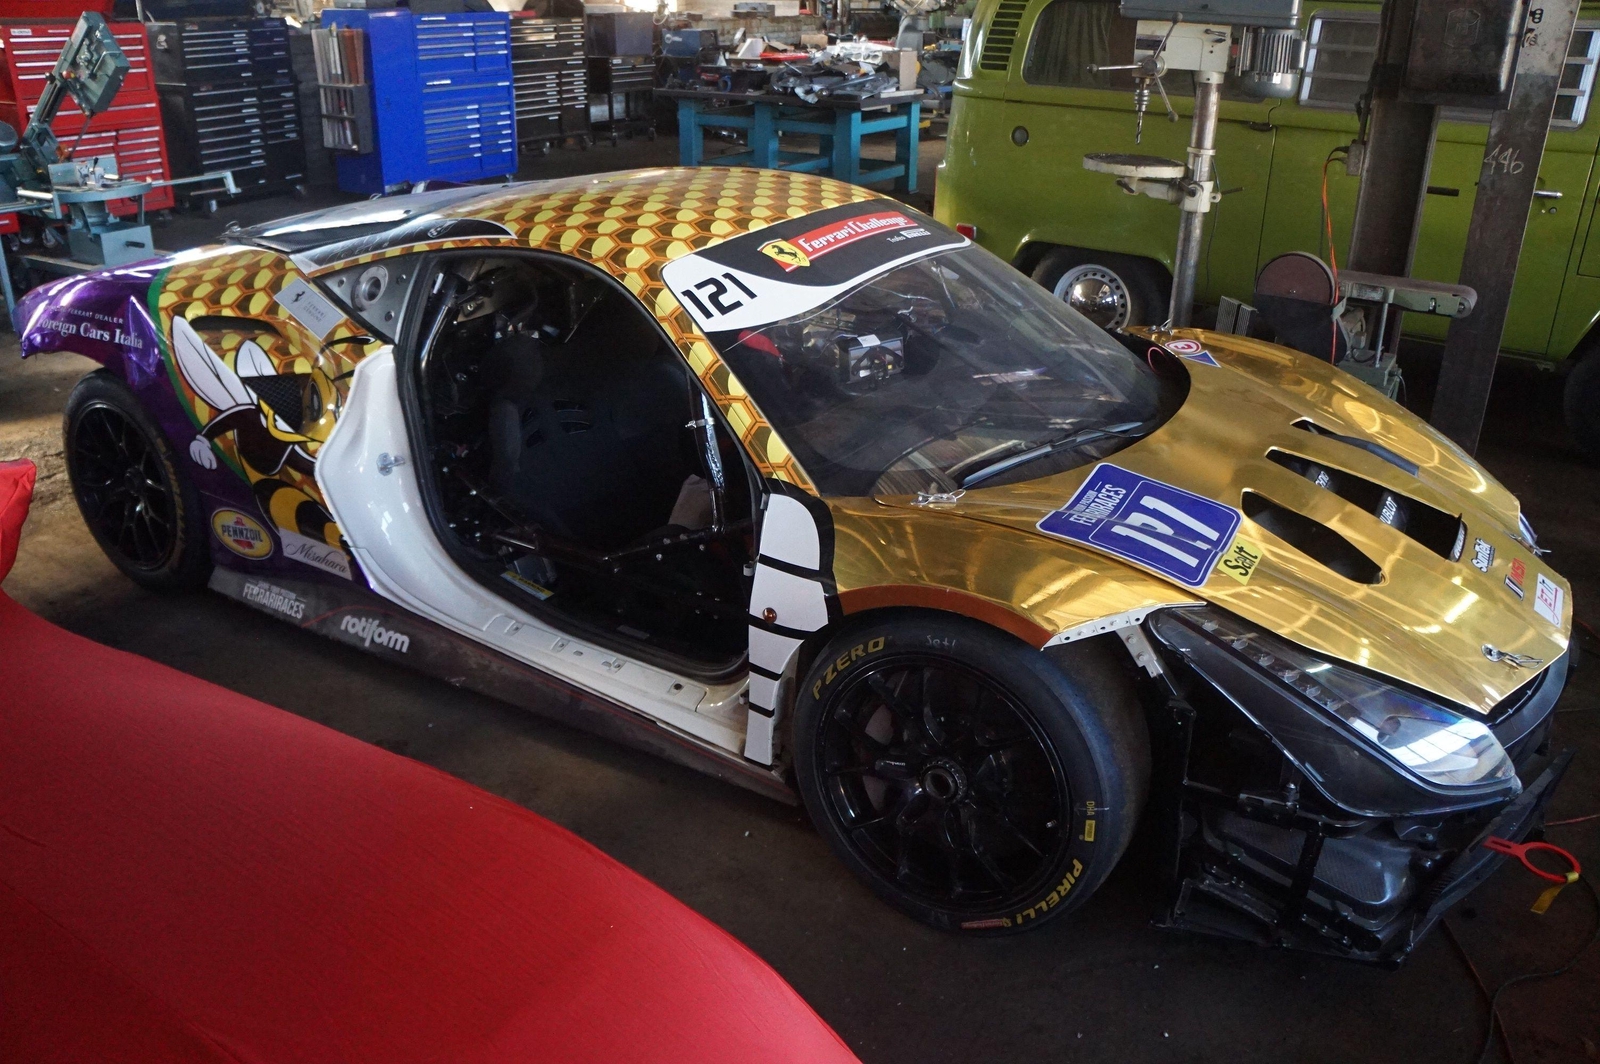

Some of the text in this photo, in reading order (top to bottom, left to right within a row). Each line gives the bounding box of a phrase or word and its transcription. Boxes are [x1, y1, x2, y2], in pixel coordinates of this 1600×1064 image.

[798, 216, 907, 252] Ferrari Challenge
[681, 272, 757, 320] 121
[80, 322, 110, 342] Cars
[114, 329, 143, 349] Italia
[94, 313, 124, 325] DEALER
[221, 524, 263, 543] PENNZOIL
[1223, 545, 1258, 577] Salt
[340, 614, 410, 653] rotiform
[1016, 858, 1083, 925] PIRELLI
